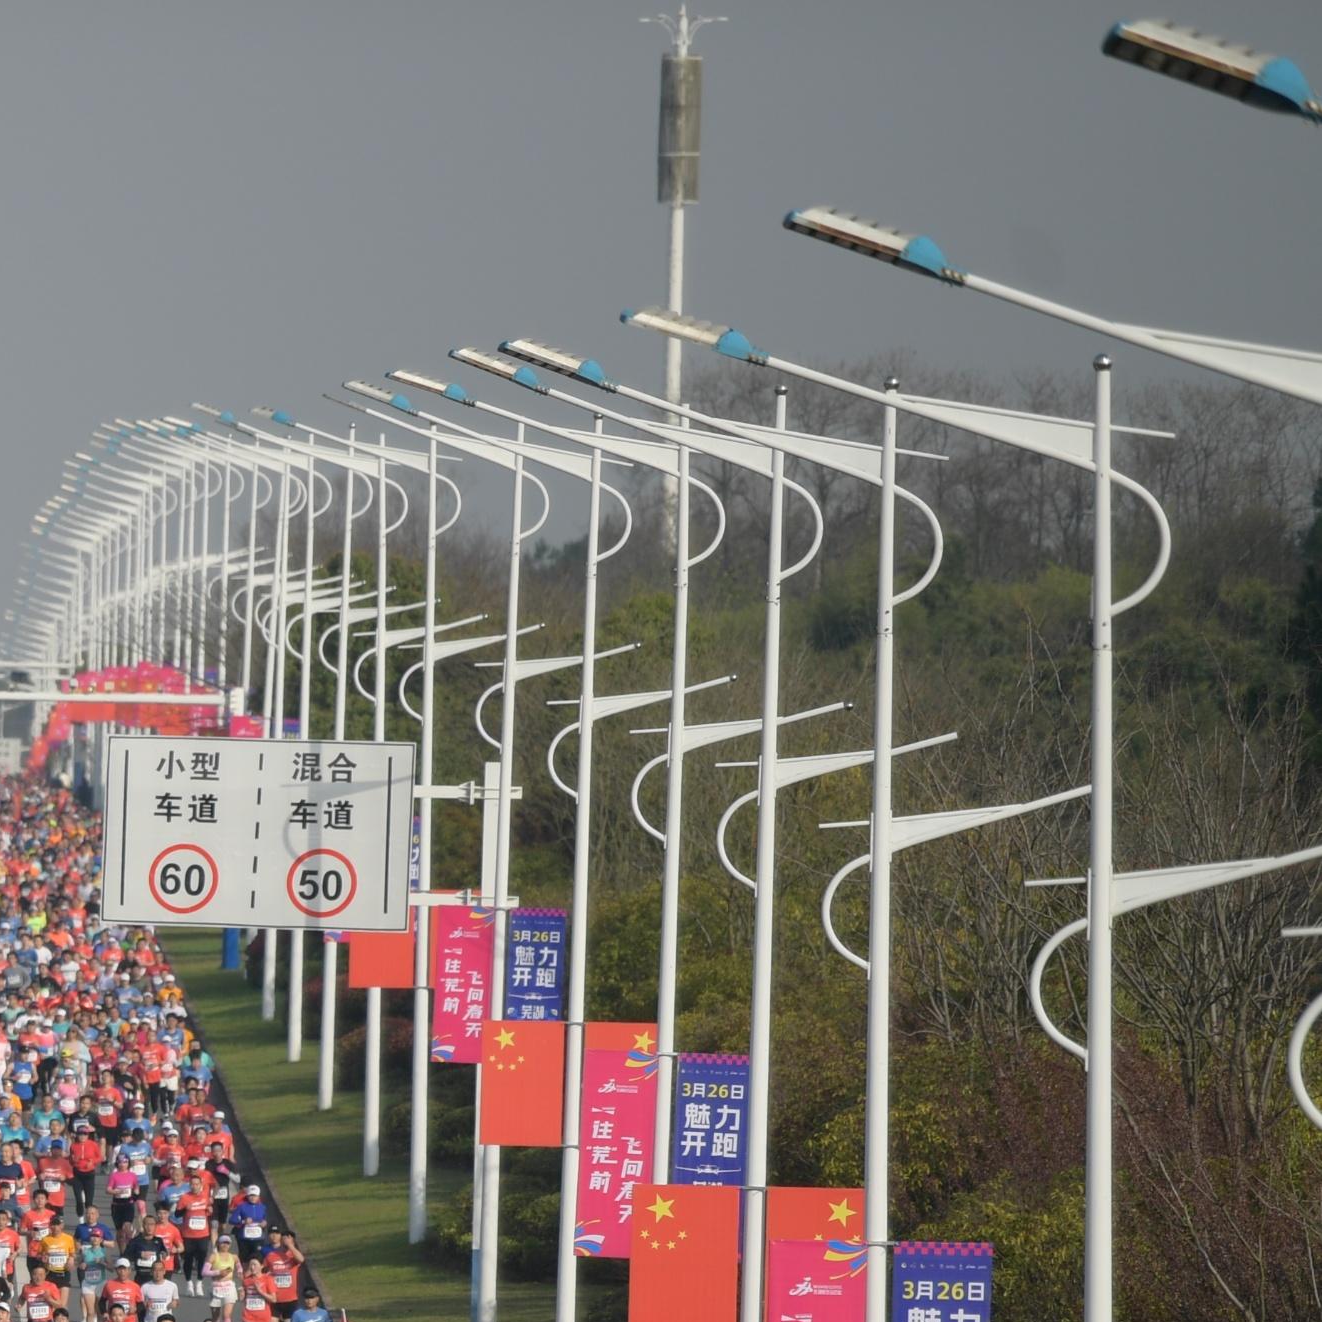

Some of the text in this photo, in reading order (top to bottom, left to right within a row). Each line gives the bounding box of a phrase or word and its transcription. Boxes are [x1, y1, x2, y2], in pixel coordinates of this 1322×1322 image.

[156, 750, 220, 781] 小型
[292, 752, 357, 783] 混合
[154, 792, 218, 824] 车道
[289, 799, 354, 830] 车道
[160, 862, 206, 896] 60
[298, 869, 343, 901] 50
[512, 930, 561, 943] 3月26日
[515, 946, 557, 967] 魅力
[512, 966, 557, 988] 开跑
[682, 1083, 744, 1099] 3月26日
[684, 1102, 740, 1131] 魅力
[680, 1131, 738, 1158] 开跑
[902, 1280, 985, 1301] 3月26日
